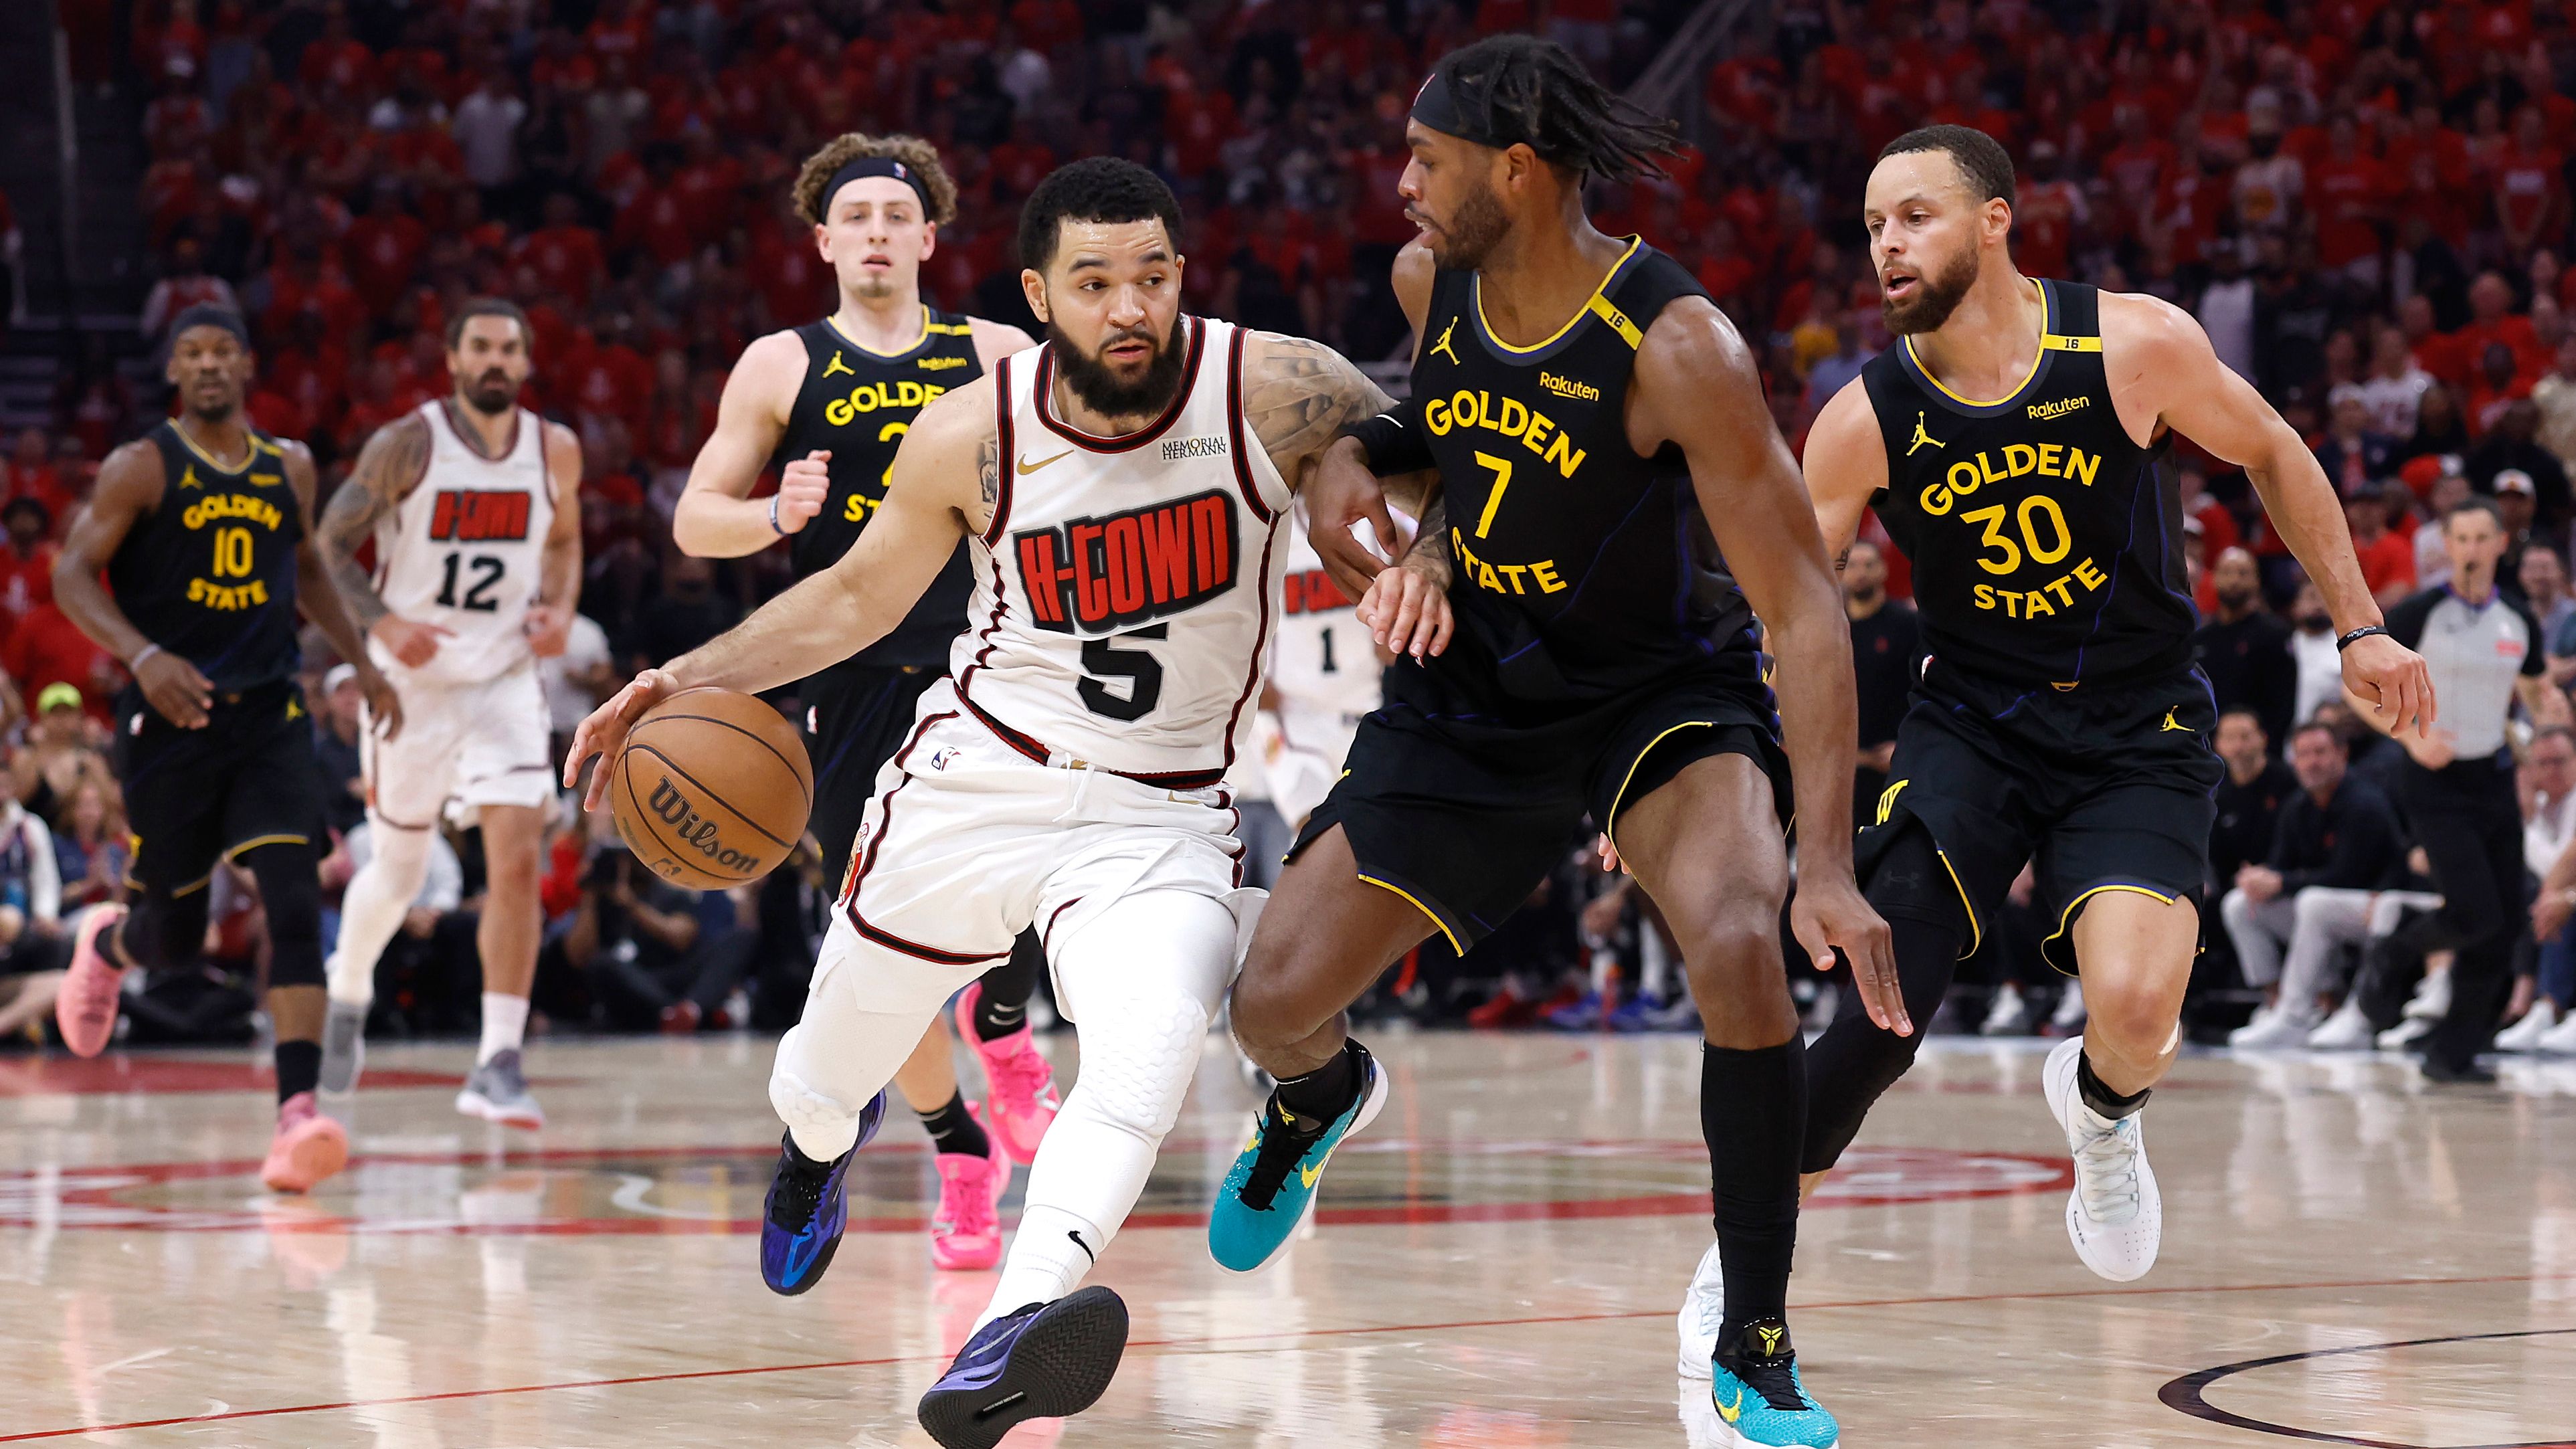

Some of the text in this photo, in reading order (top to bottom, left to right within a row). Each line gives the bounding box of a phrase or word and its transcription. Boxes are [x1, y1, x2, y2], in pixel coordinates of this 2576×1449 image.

[1608, 311, 1625, 328] 16
[2065, 339, 2080, 349] 16
[825, 381, 951, 426] GOLDE
[1540, 371, 1600, 401] Rakuten
[2027, 396, 2090, 419] Rakuten
[1162, 436, 1226, 452] MEMORIAL
[1163, 446, 1226, 460] HERMANN
[1426, 390, 1586, 478] GOLDEN
[1474, 450, 1512, 539] 7
[1920, 443, 2102, 516] GOLDEN
[182, 493, 283, 531] GOLDEN
[213, 526, 254, 577] 10
[1959, 495, 2072, 575] 30
[187, 577, 269, 611] STATE
[436, 551, 505, 611] 12
[1974, 557, 2108, 619] STATE
[1075, 621, 1170, 723] 5
[1321, 627, 1337, 672] 1
[649, 775, 761, 873] Wilson
